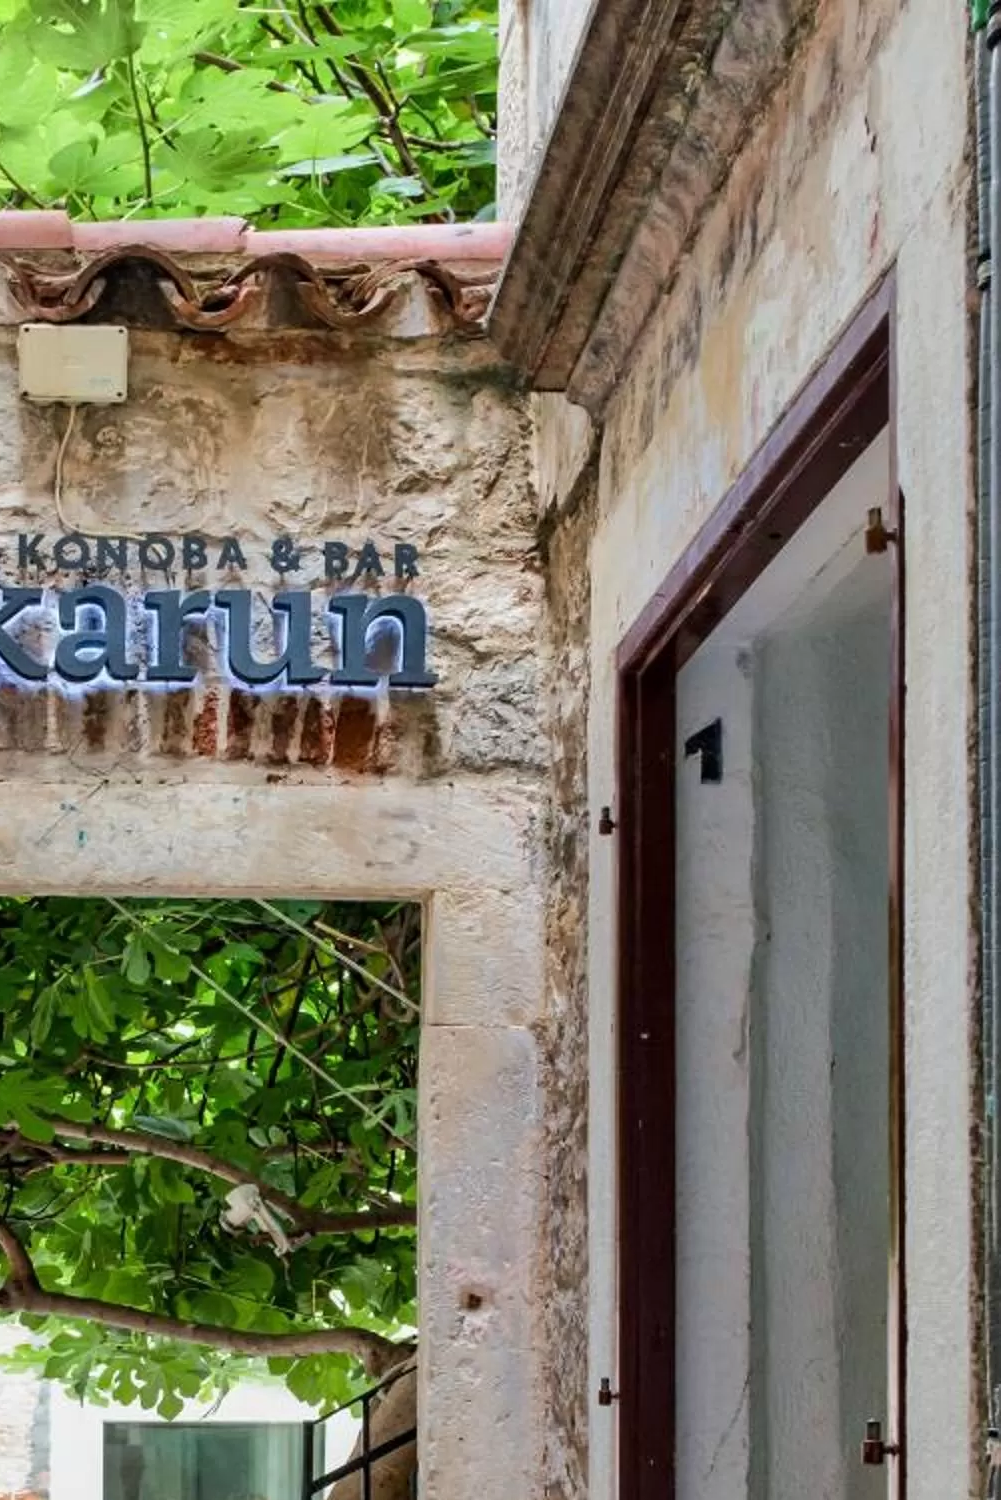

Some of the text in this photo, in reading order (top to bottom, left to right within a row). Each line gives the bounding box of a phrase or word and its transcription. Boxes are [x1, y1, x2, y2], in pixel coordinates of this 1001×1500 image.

[17, 532, 420, 577] KONOBA & BAR
[684, 717, 723, 784] 1
